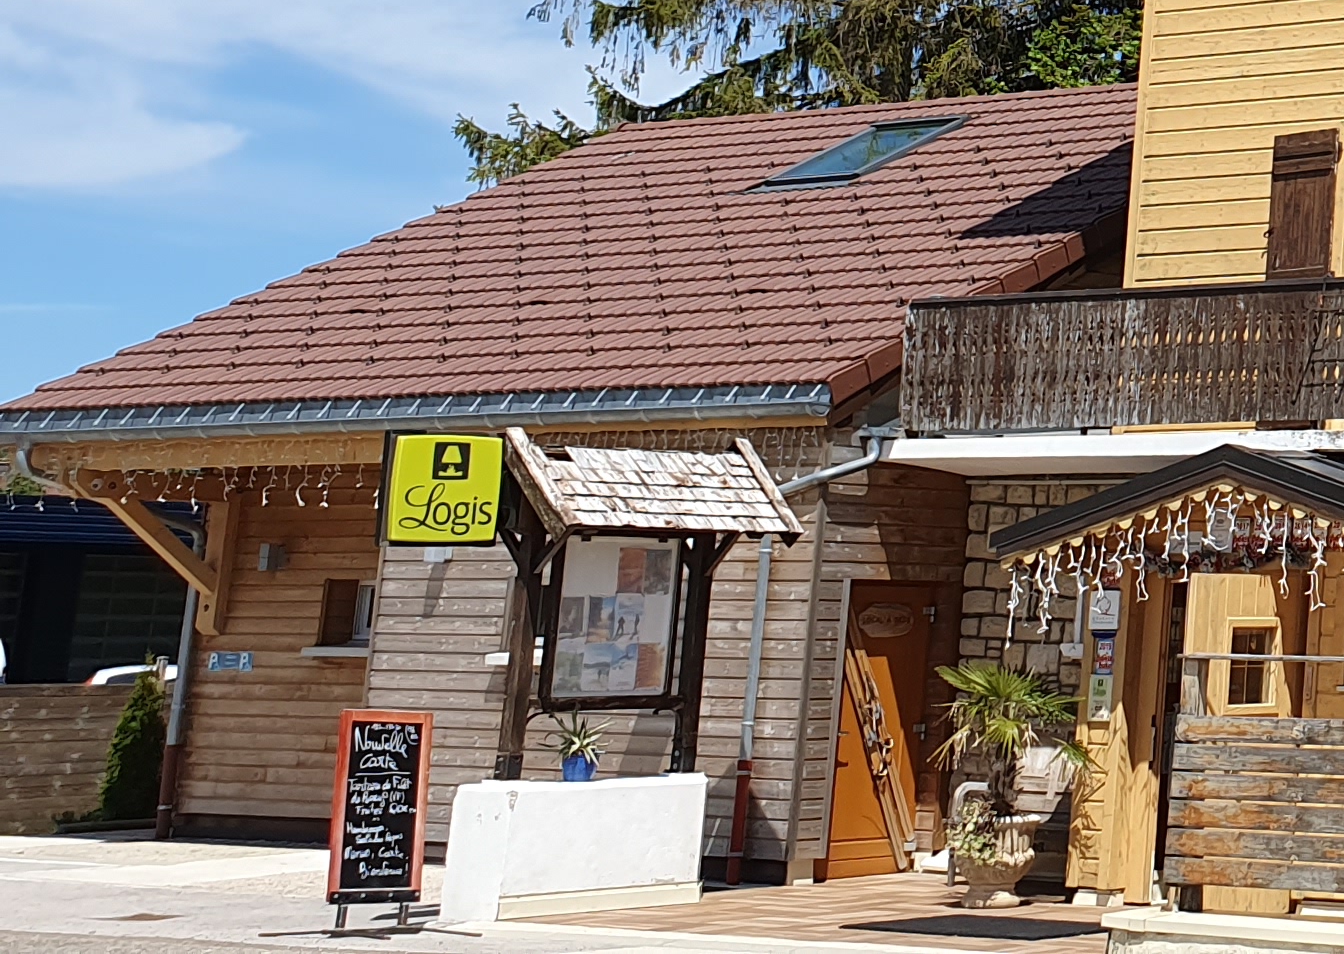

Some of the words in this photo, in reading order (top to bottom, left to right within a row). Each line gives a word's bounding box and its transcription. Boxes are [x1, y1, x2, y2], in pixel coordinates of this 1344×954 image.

[398, 482, 493, 536] Logis
[354, 725, 408, 759] Nouvelle
[359, 752, 399, 771] Carte
